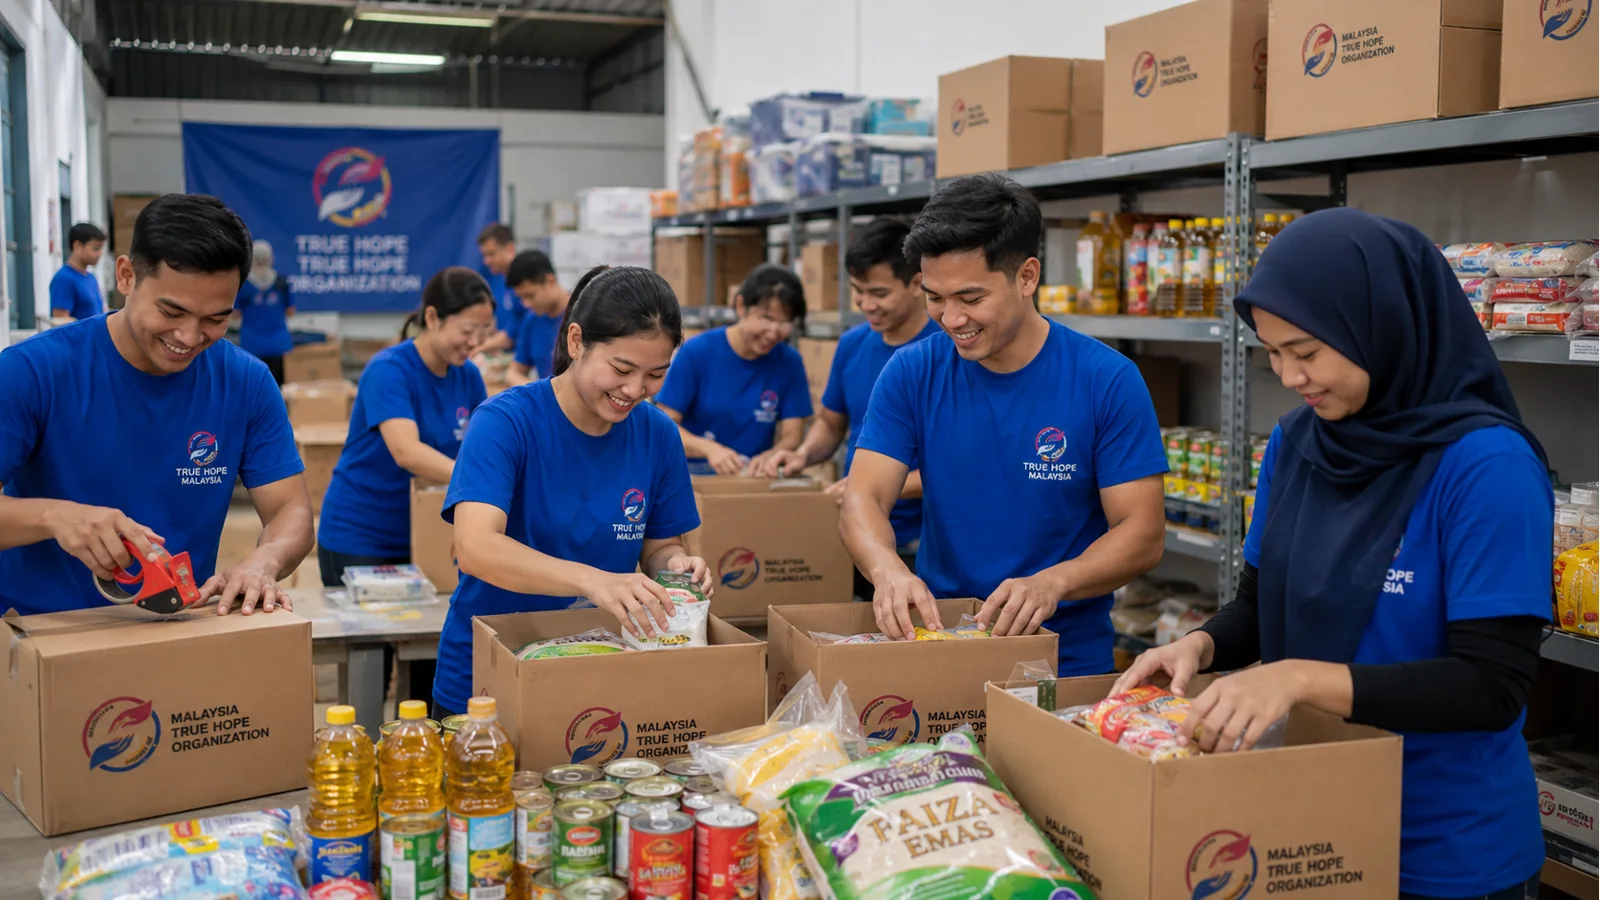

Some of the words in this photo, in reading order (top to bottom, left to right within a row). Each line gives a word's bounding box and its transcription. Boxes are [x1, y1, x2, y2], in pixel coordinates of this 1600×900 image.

[1341, 26, 1378, 42] MALAYSIA
[1341, 42, 1361, 52] TRUE
[1363, 36, 1384, 48] HOPE
[1341, 45, 1395, 64] ORGANIZATION
[295, 234, 350, 254] TRUE
[353, 234, 409, 254] HOPE
[297, 254, 350, 274] TRUE
[353, 254, 408, 274] HOPE
[176, 467, 201, 476] TRUE
[203, 466, 228, 476] HOPE
[1023, 462, 1048, 472] TRUE
[1051, 463, 1077, 472] HOPE
[181, 475, 222, 485] MALAYSIA
[1028, 471, 1071, 480] MALAYSIA
[612, 523, 633, 532] TRUE
[1386, 568, 1415, 583] OPE
[171, 704, 239, 724] MALAYSIA
[928, 709, 986, 721] MALAYSIA
[171, 723, 208, 739] TRUE
[213, 717, 250, 732] HOPE
[636, 719, 697, 733] MALAYSIA
[171, 727, 270, 753] ORGANIZATION
[636, 734, 669, 746] TRUE
[636, 745, 690, 758] ORGANIZ
[867, 791, 999, 844] FAIZA
[902, 820, 995, 859] EMAS
[1267, 842, 1334, 861] MALAYSIA
[1267, 863, 1303, 878] TRUE
[1307, 857, 1344, 872] HOPE
[1266, 870, 1363, 894] ORGANIZATION
